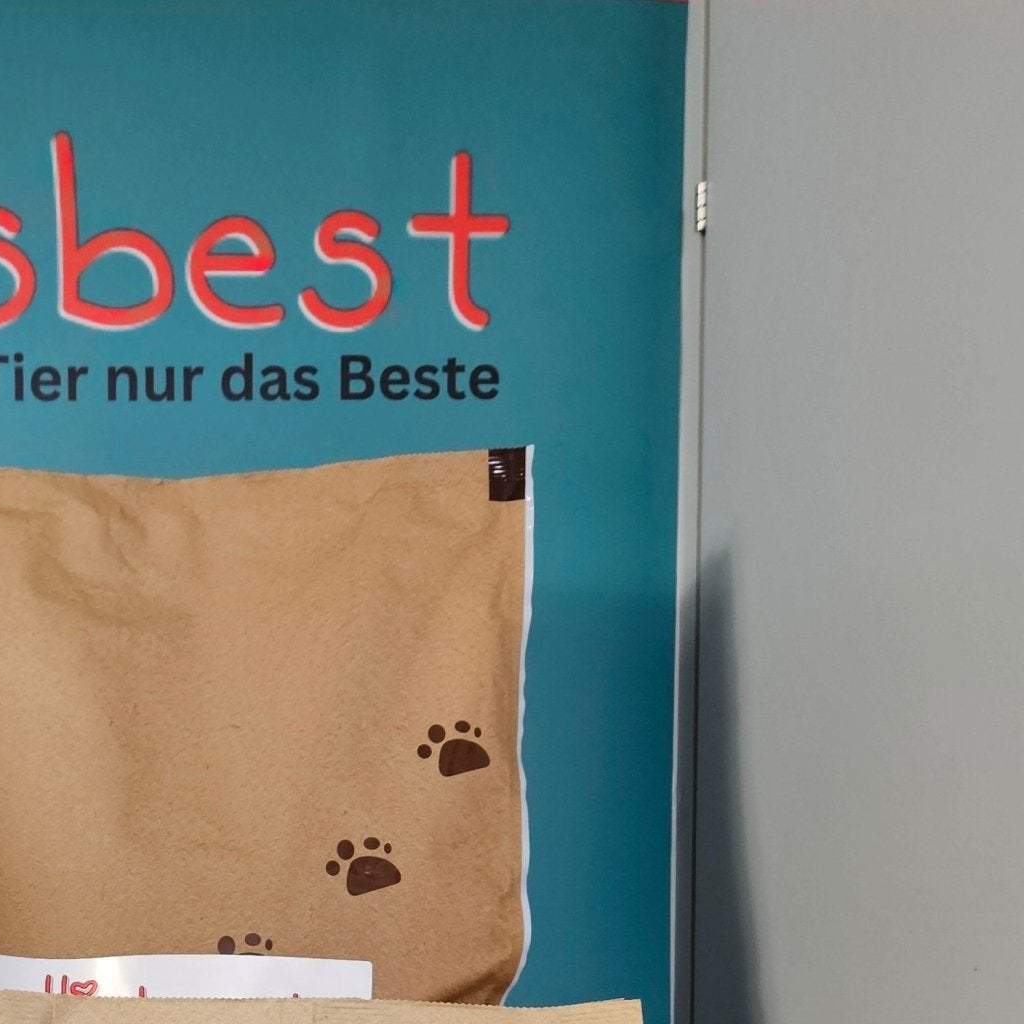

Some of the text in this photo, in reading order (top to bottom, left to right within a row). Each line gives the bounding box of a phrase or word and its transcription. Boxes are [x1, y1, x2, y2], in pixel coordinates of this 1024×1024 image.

[106, 364, 204, 401] nur
[219, 353, 321, 401] das
[339, 355, 500, 401] Beste
